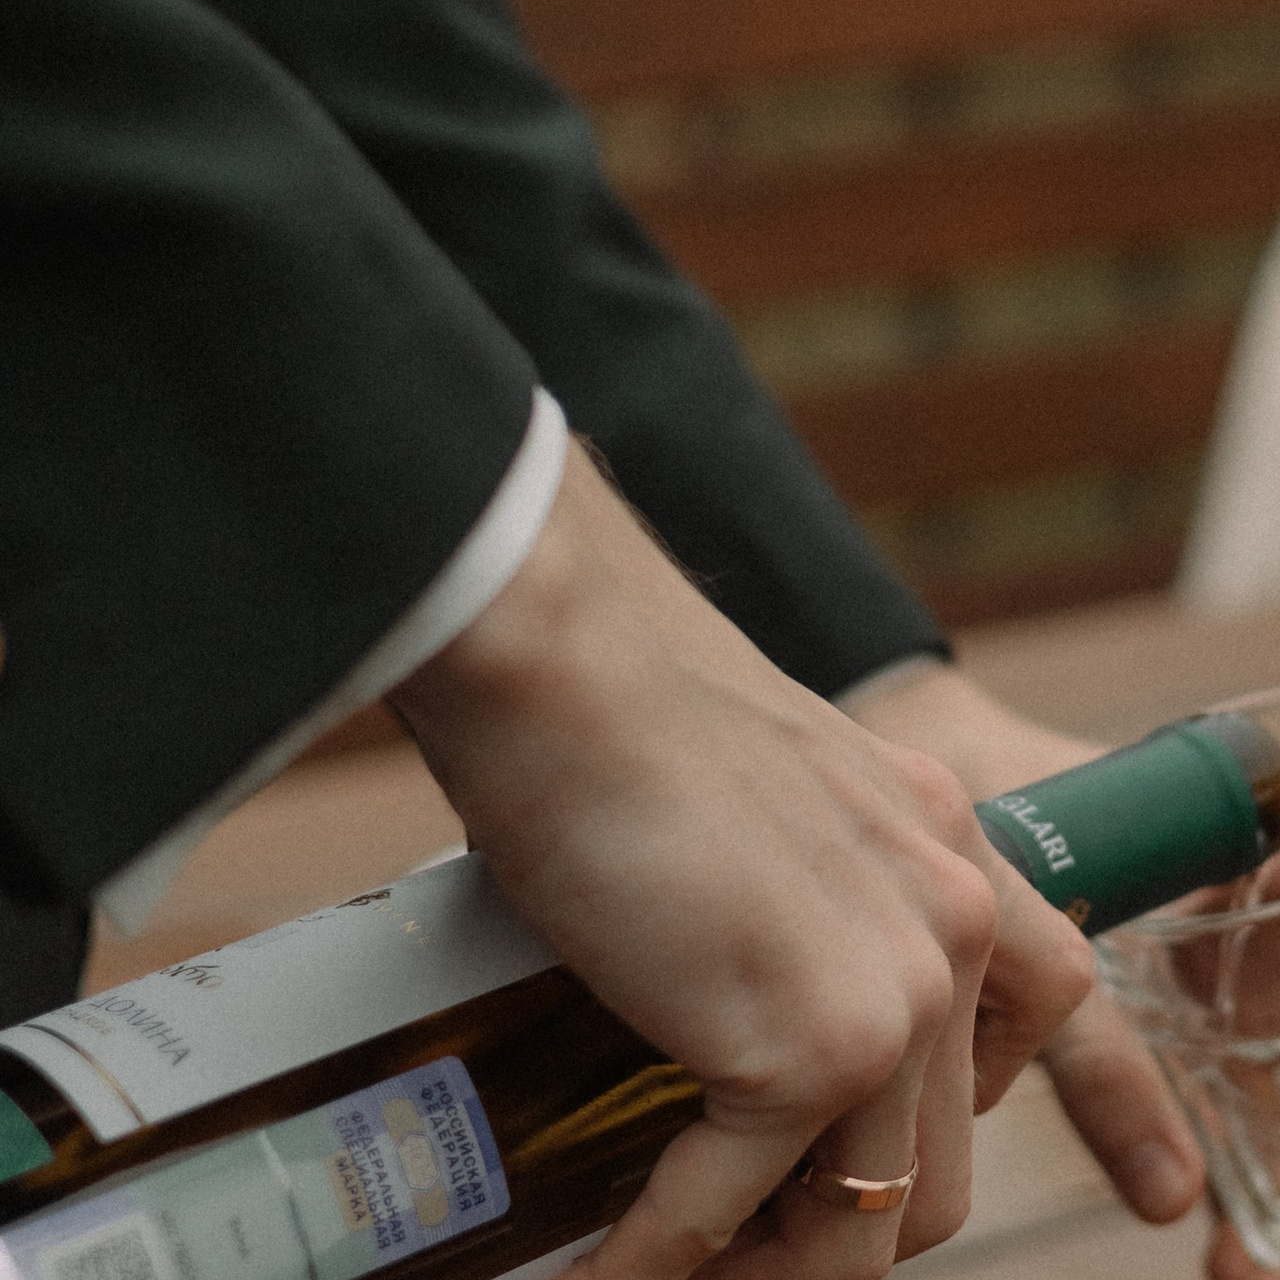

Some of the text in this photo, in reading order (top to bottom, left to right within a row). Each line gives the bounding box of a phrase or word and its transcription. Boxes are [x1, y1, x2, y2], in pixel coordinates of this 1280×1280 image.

[992, 795, 1076, 874] GLARI
[335, 1157, 367, 1222] МАРКА
[336, 1115, 392, 1250] СПЕЦИАЛЬНАЯ
[351, 1110, 407, 1244] ФЕДЕРАЛЬНАЯ
[420, 1087, 473, 1212] ФЕДЕРАЦИЯ
[433, 1080, 487, 1207] РОССИЙСКАЯ
